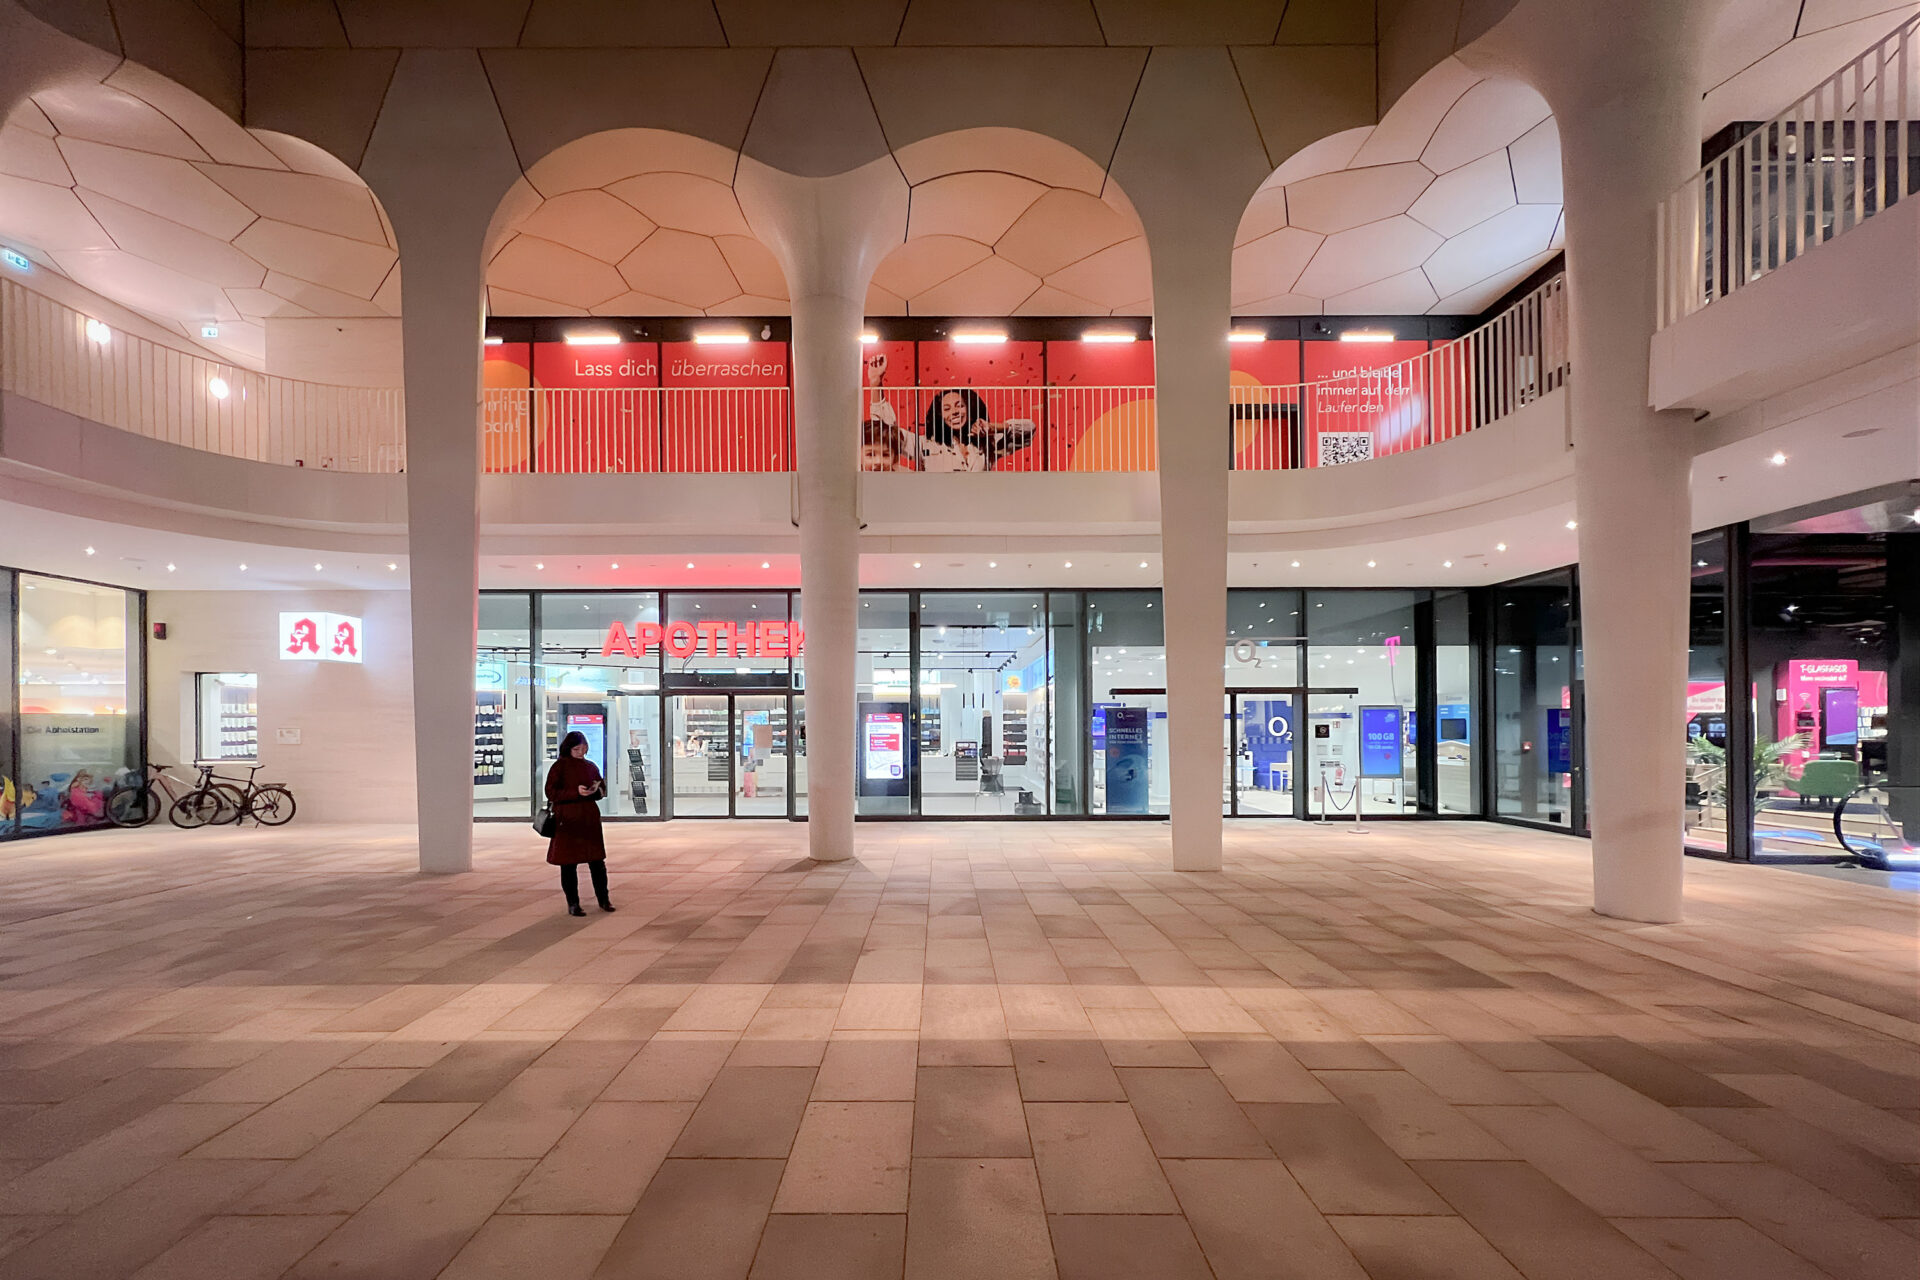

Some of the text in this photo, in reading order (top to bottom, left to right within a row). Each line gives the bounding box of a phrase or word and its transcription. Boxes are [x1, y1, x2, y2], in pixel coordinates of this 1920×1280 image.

[575, 359, 784, 376] Lass dich überraschen
[1332, 365, 1357, 378] und
[1360, 365, 1401, 378] bleibe
[1317, 383, 1358, 396] immer
[601, 621, 805, 658] APOTHEK
